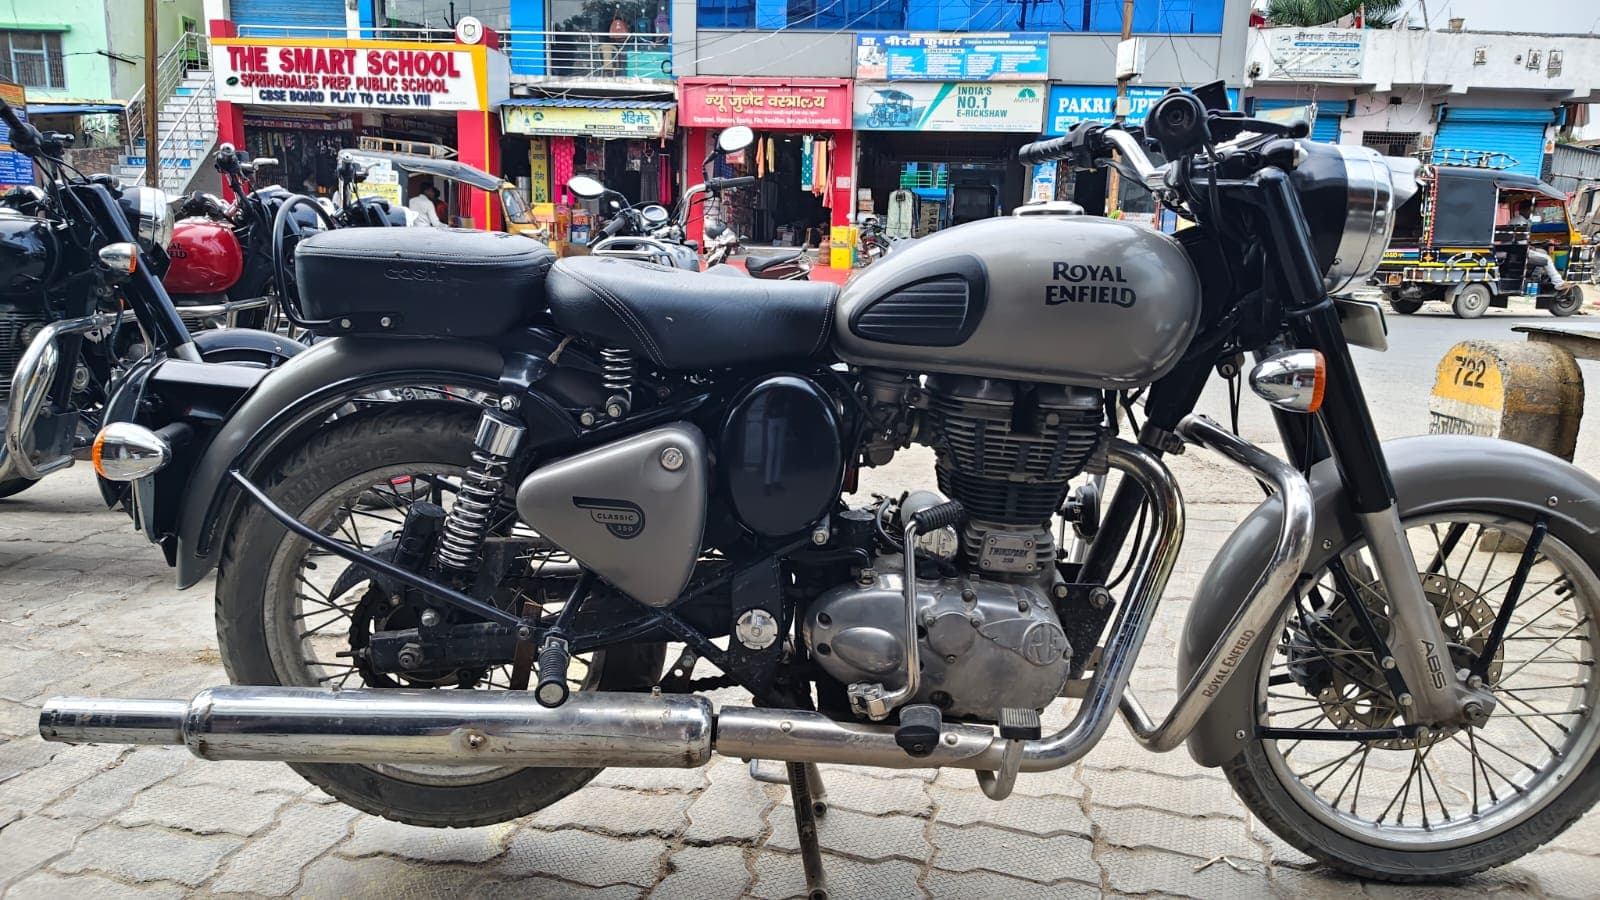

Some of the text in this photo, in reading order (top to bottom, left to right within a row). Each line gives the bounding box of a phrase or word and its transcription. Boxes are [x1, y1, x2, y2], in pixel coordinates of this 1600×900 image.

[885, 35, 921, 47] नीरज
[924, 37, 962, 49] कुमार
[227, 46, 460, 78] THE SMART SCHOOL
[240, 73, 319, 89] SPRINGDALES
[356, 77, 398, 92] PUBLIC
[401, 78, 449, 93] SCHOOL
[958, 86, 992, 96] INDIA'S
[259, 90, 431, 106] CBSE BOARD PLAY TO CLASS VIII
[705, 91, 826, 113] न्यू जुनैद वस्त्रालय
[1058, 97, 1111, 113] PAKRI
[957, 109, 1008, 118] E-RICKSHAW
[1052, 261, 1127, 283] ROYAL
[1045, 285, 1137, 308] ENFIELD
[1454, 355, 1486, 389] 722
[597, 512, 634, 521] CLASSIC
[1202, 629, 1256, 699] ROYAL ENFIELD
[1421, 639, 1447, 690] ABS
